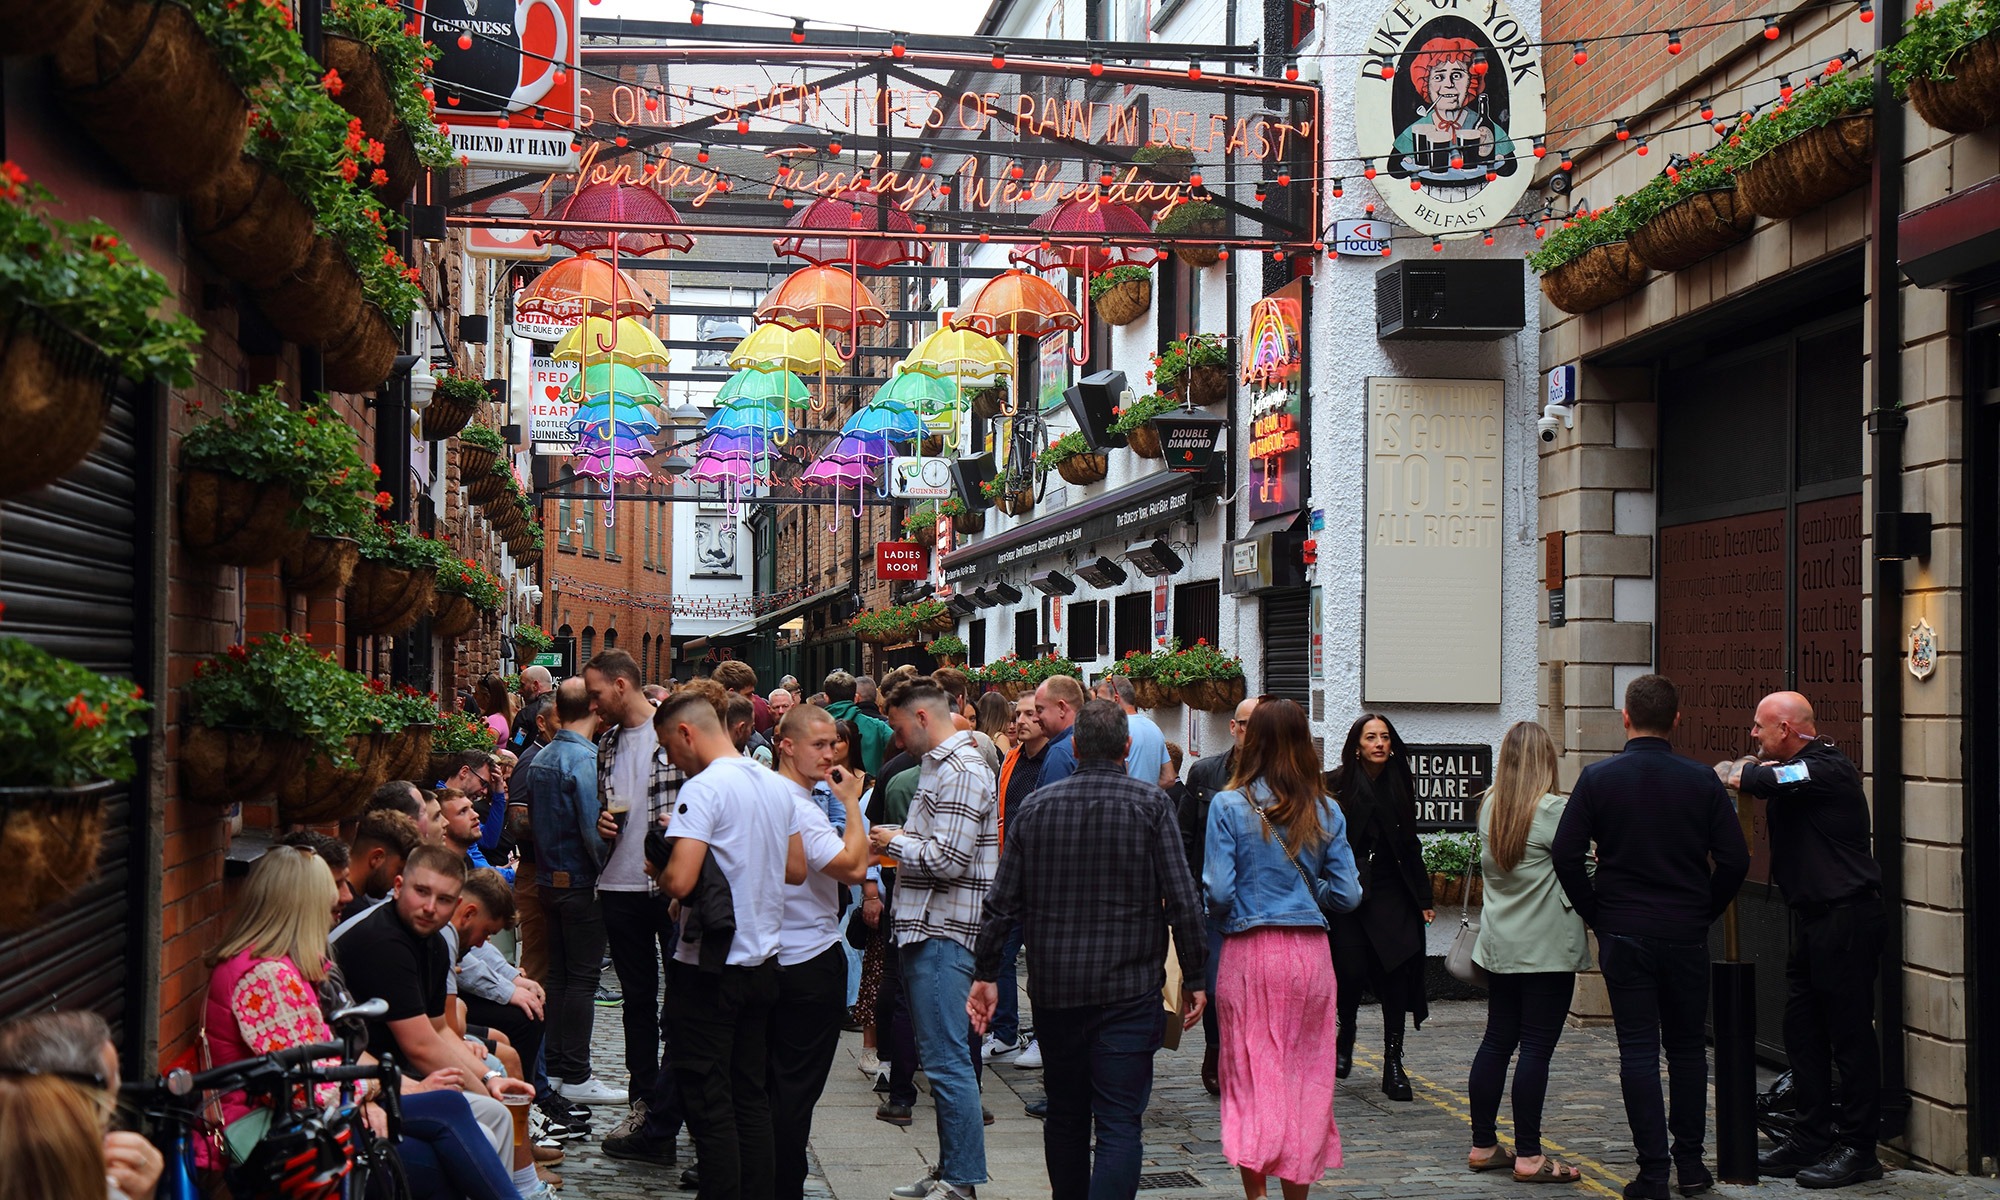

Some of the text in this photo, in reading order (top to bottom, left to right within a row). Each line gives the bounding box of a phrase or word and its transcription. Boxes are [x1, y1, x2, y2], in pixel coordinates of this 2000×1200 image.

[432, 19, 511, 36] GUINNESS
[1361, 0, 1539, 86] DUKE YORK
[613, 84, 693, 126] ONLY
[713, 83, 821, 126] SEVEN
[838, 85, 944, 129] TYPES
[959, 91, 1000, 131] OF
[1015, 94, 1093, 140] RAIN
[1107, 103, 1137, 144] IN
[451, 133, 503, 153] FRIEND
[506, 138, 525, 154] AT
[527, 139, 567, 157] HAND
[1414, 203, 1487, 229] BELFAST
[1344, 235, 1385, 251] focus
[517, 323, 532, 333] THE
[532, 325, 552, 335] DUKE
[553, 327, 564, 335] OF
[538, 371, 569, 383] RED
[532, 405, 578, 417] HEART
[1374, 384, 1498, 412] EVERYTHING
[531, 430, 577, 441] GUINNESS
[536, 419, 570, 428] BOTTLED
[1172, 429, 1208, 438] DOUBLE
[1374, 413, 1497, 452] IS GOING
[1168, 438, 1211, 449] DIAMOND
[909, 487, 949, 496] GUINNESS
[1374, 453, 1497, 514] TO BE
[1374, 514, 1497, 548] ALL RIGHT
[883, 550, 921, 560] LADIES
[1664, 531, 1688, 564] Had
[1691, 530, 1696, 561] I
[1700, 528, 1720, 560] the
[886, 562, 919, 573] ROOM
[1802, 548, 1836, 591] and
[1718, 568, 1742, 595] with
[1745, 565, 1783, 599] golden
[1664, 602, 1783, 635] The blue and the dim
[1802, 597, 1857, 633] and the
[704, 647, 733, 662] AR
[1663, 641, 1782, 676] Of night and light and
[1802, 640, 1835, 683] the
[1710, 677, 1755, 716] spread
[1700, 716, 1740, 760] being
[1414, 778, 1469, 798] UARE
